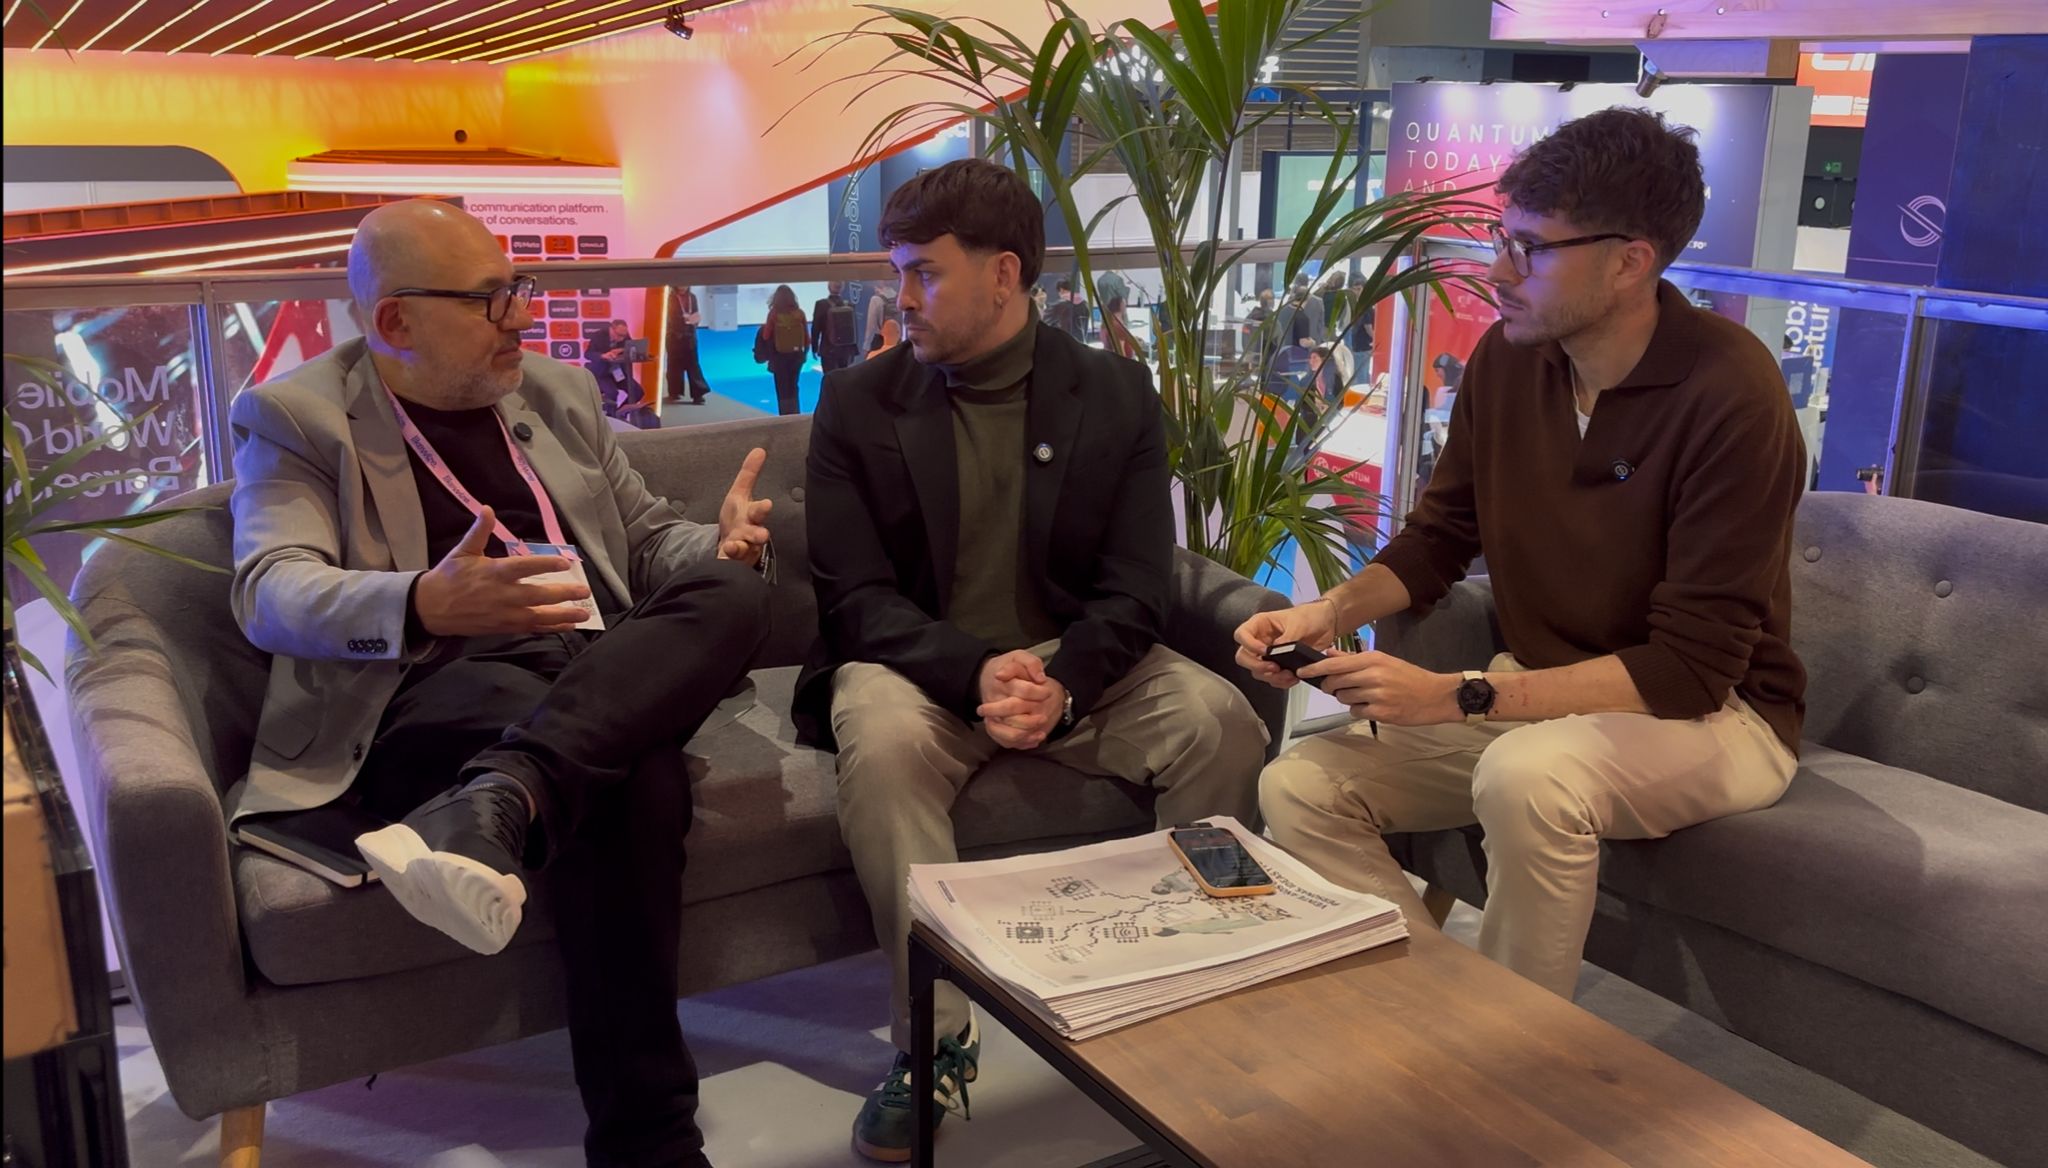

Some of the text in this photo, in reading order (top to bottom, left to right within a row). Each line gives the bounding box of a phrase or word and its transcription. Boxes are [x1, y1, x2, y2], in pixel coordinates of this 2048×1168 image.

[1406, 121, 1550, 146] QUANTUM
[1406, 149, 1502, 173] TODAY
[1403, 178, 1457, 195] AND
[470, 202, 557, 213] communication
[486, 215, 498, 225] of
[499, 215, 578, 226] conversations.
